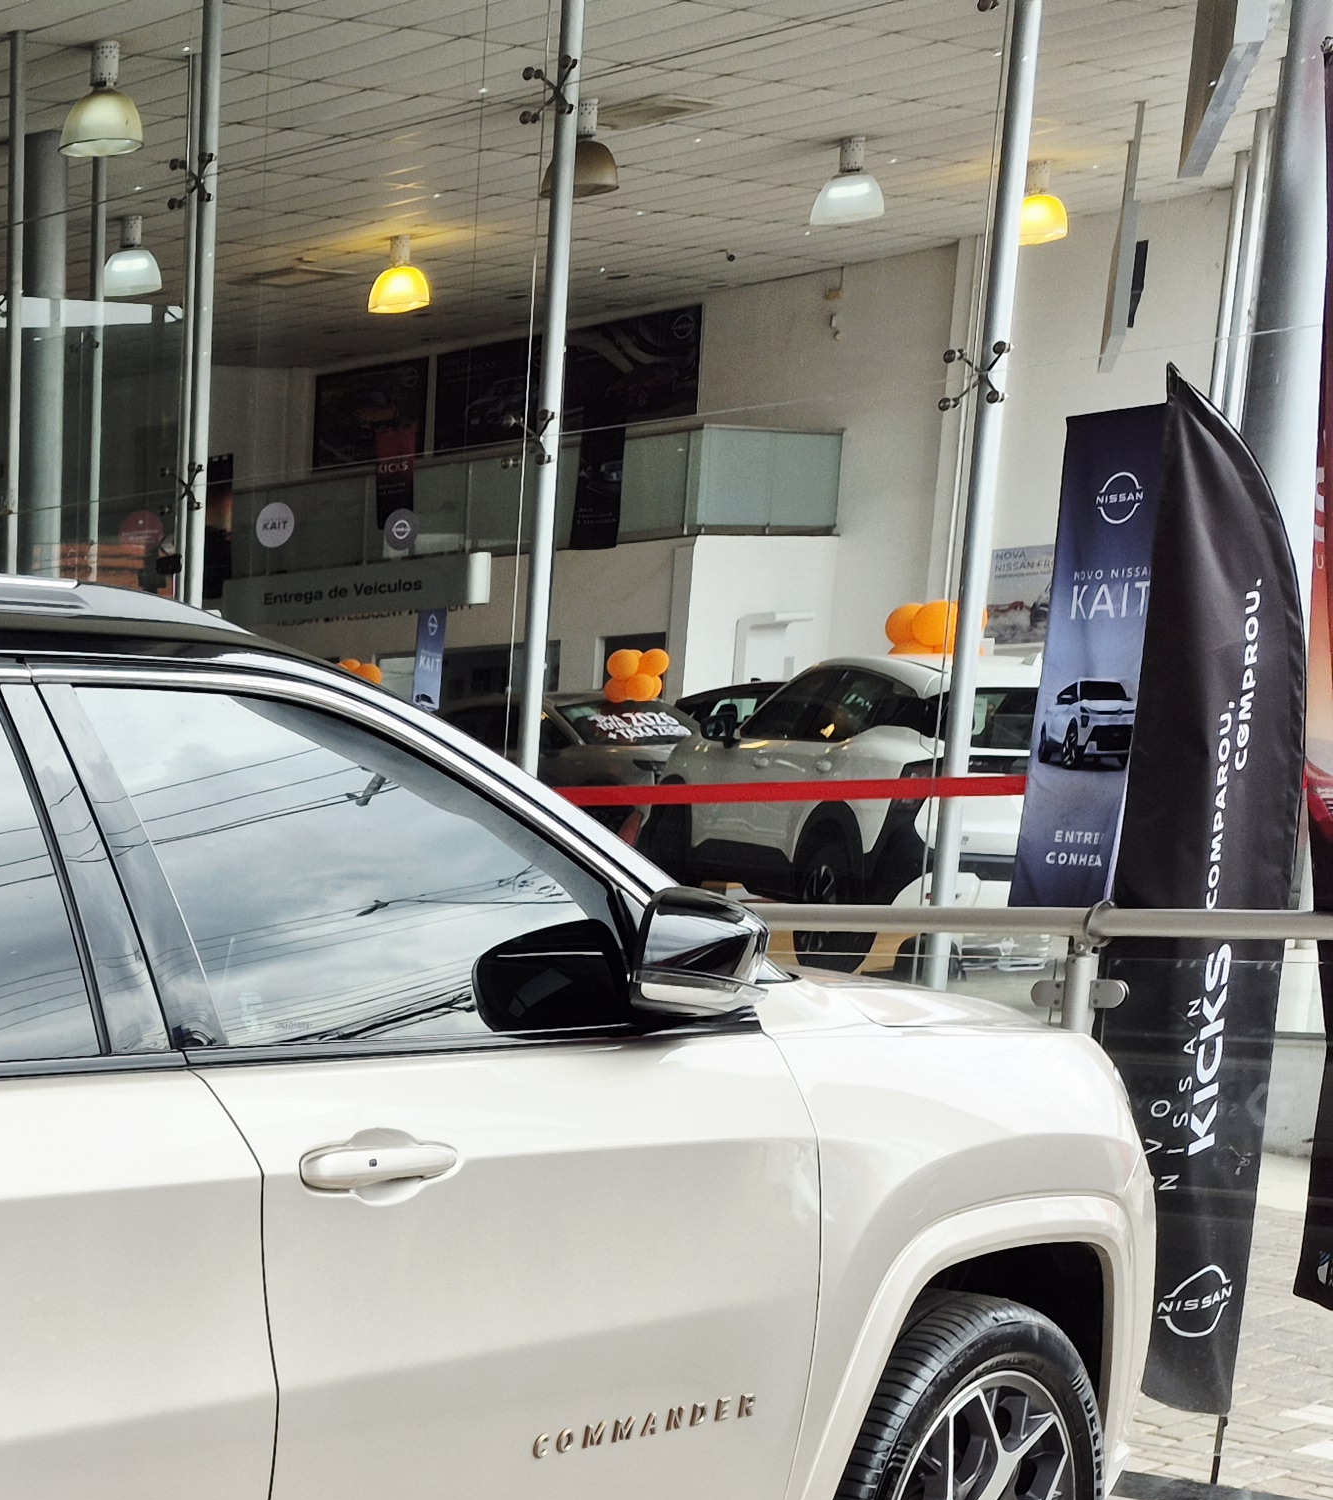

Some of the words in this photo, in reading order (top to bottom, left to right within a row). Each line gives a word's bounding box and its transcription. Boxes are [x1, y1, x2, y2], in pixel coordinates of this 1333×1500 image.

[1096, 490, 1144, 505] NISSAN
[262, 520, 288, 531] KAIT
[994, 561, 1035, 573] NISSAN
[995, 550, 1027, 561] NOVA
[1073, 569, 1104, 582] NOVO
[1110, 566, 1151, 579] NISSA
[263, 590, 323, 605] Entrega
[329, 585, 348, 599] de
[354, 579, 423, 598] Veículos
[1070, 580, 1151, 621] KAIT
[418, 655, 442, 672] KAIT
[1234, 577, 1263, 772] COMPROU.
[1187, 943, 1232, 1157] KICKS
[1158, 998, 1201, 1191] NISSAN
[1156, 1285, 1233, 1314] NISSAN
[532, 1392, 757, 1460] COMMANDER
